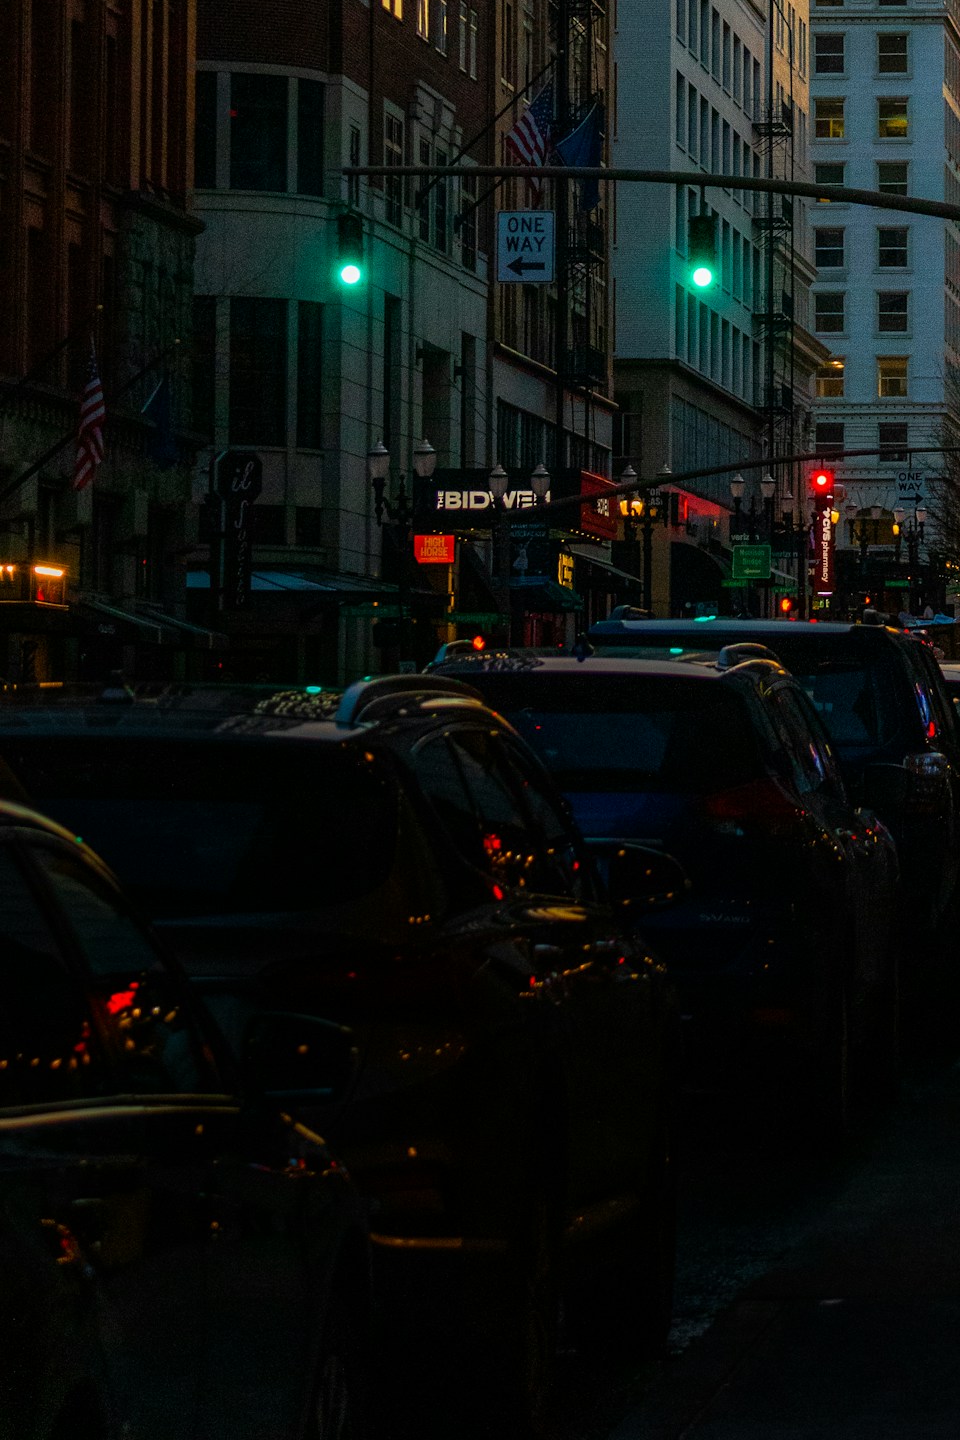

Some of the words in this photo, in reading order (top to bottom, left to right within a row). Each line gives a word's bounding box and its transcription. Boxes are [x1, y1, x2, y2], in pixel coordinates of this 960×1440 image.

[507, 216, 545, 233] ONE
[506, 236, 546, 252] WAY
[898, 472, 922, 482] ONE
[898, 483, 923, 492] WAY
[822, 520, 832, 541] CVS
[424, 537, 445, 547] HIGH
[420, 546, 449, 557] HORSE
[820, 541, 830, 583] pharmacy
